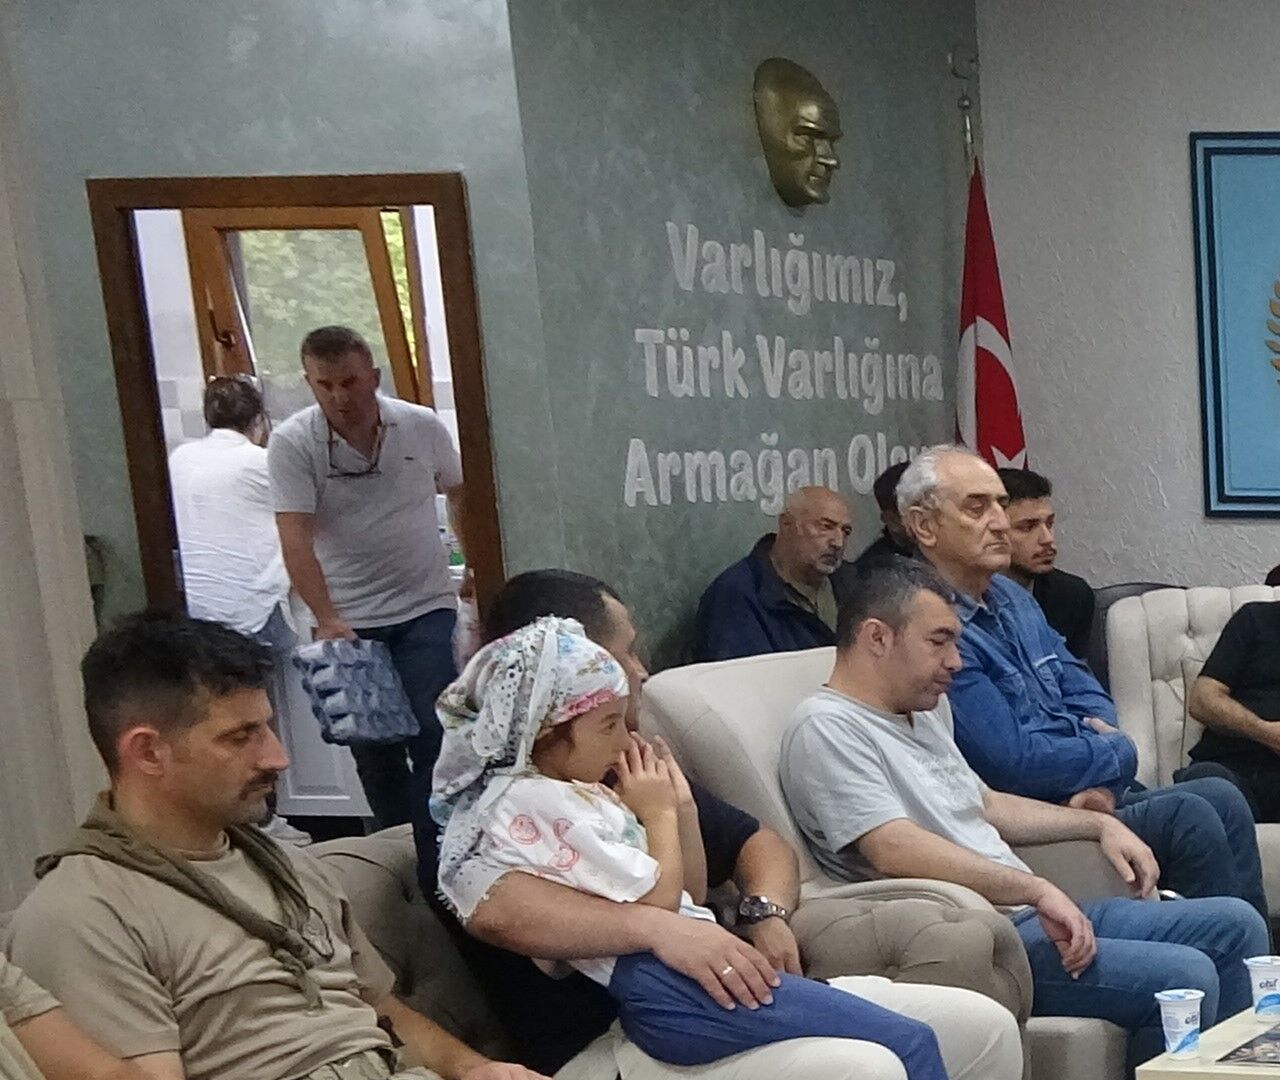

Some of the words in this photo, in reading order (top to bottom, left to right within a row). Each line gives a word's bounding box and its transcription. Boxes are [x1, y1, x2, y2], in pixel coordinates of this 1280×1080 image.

[666, 221, 908, 322] Varlığımız,
[635, 328, 749, 399] Türk
[756, 334, 943, 415] Varlığına
[624, 432, 838, 516] Armağan
